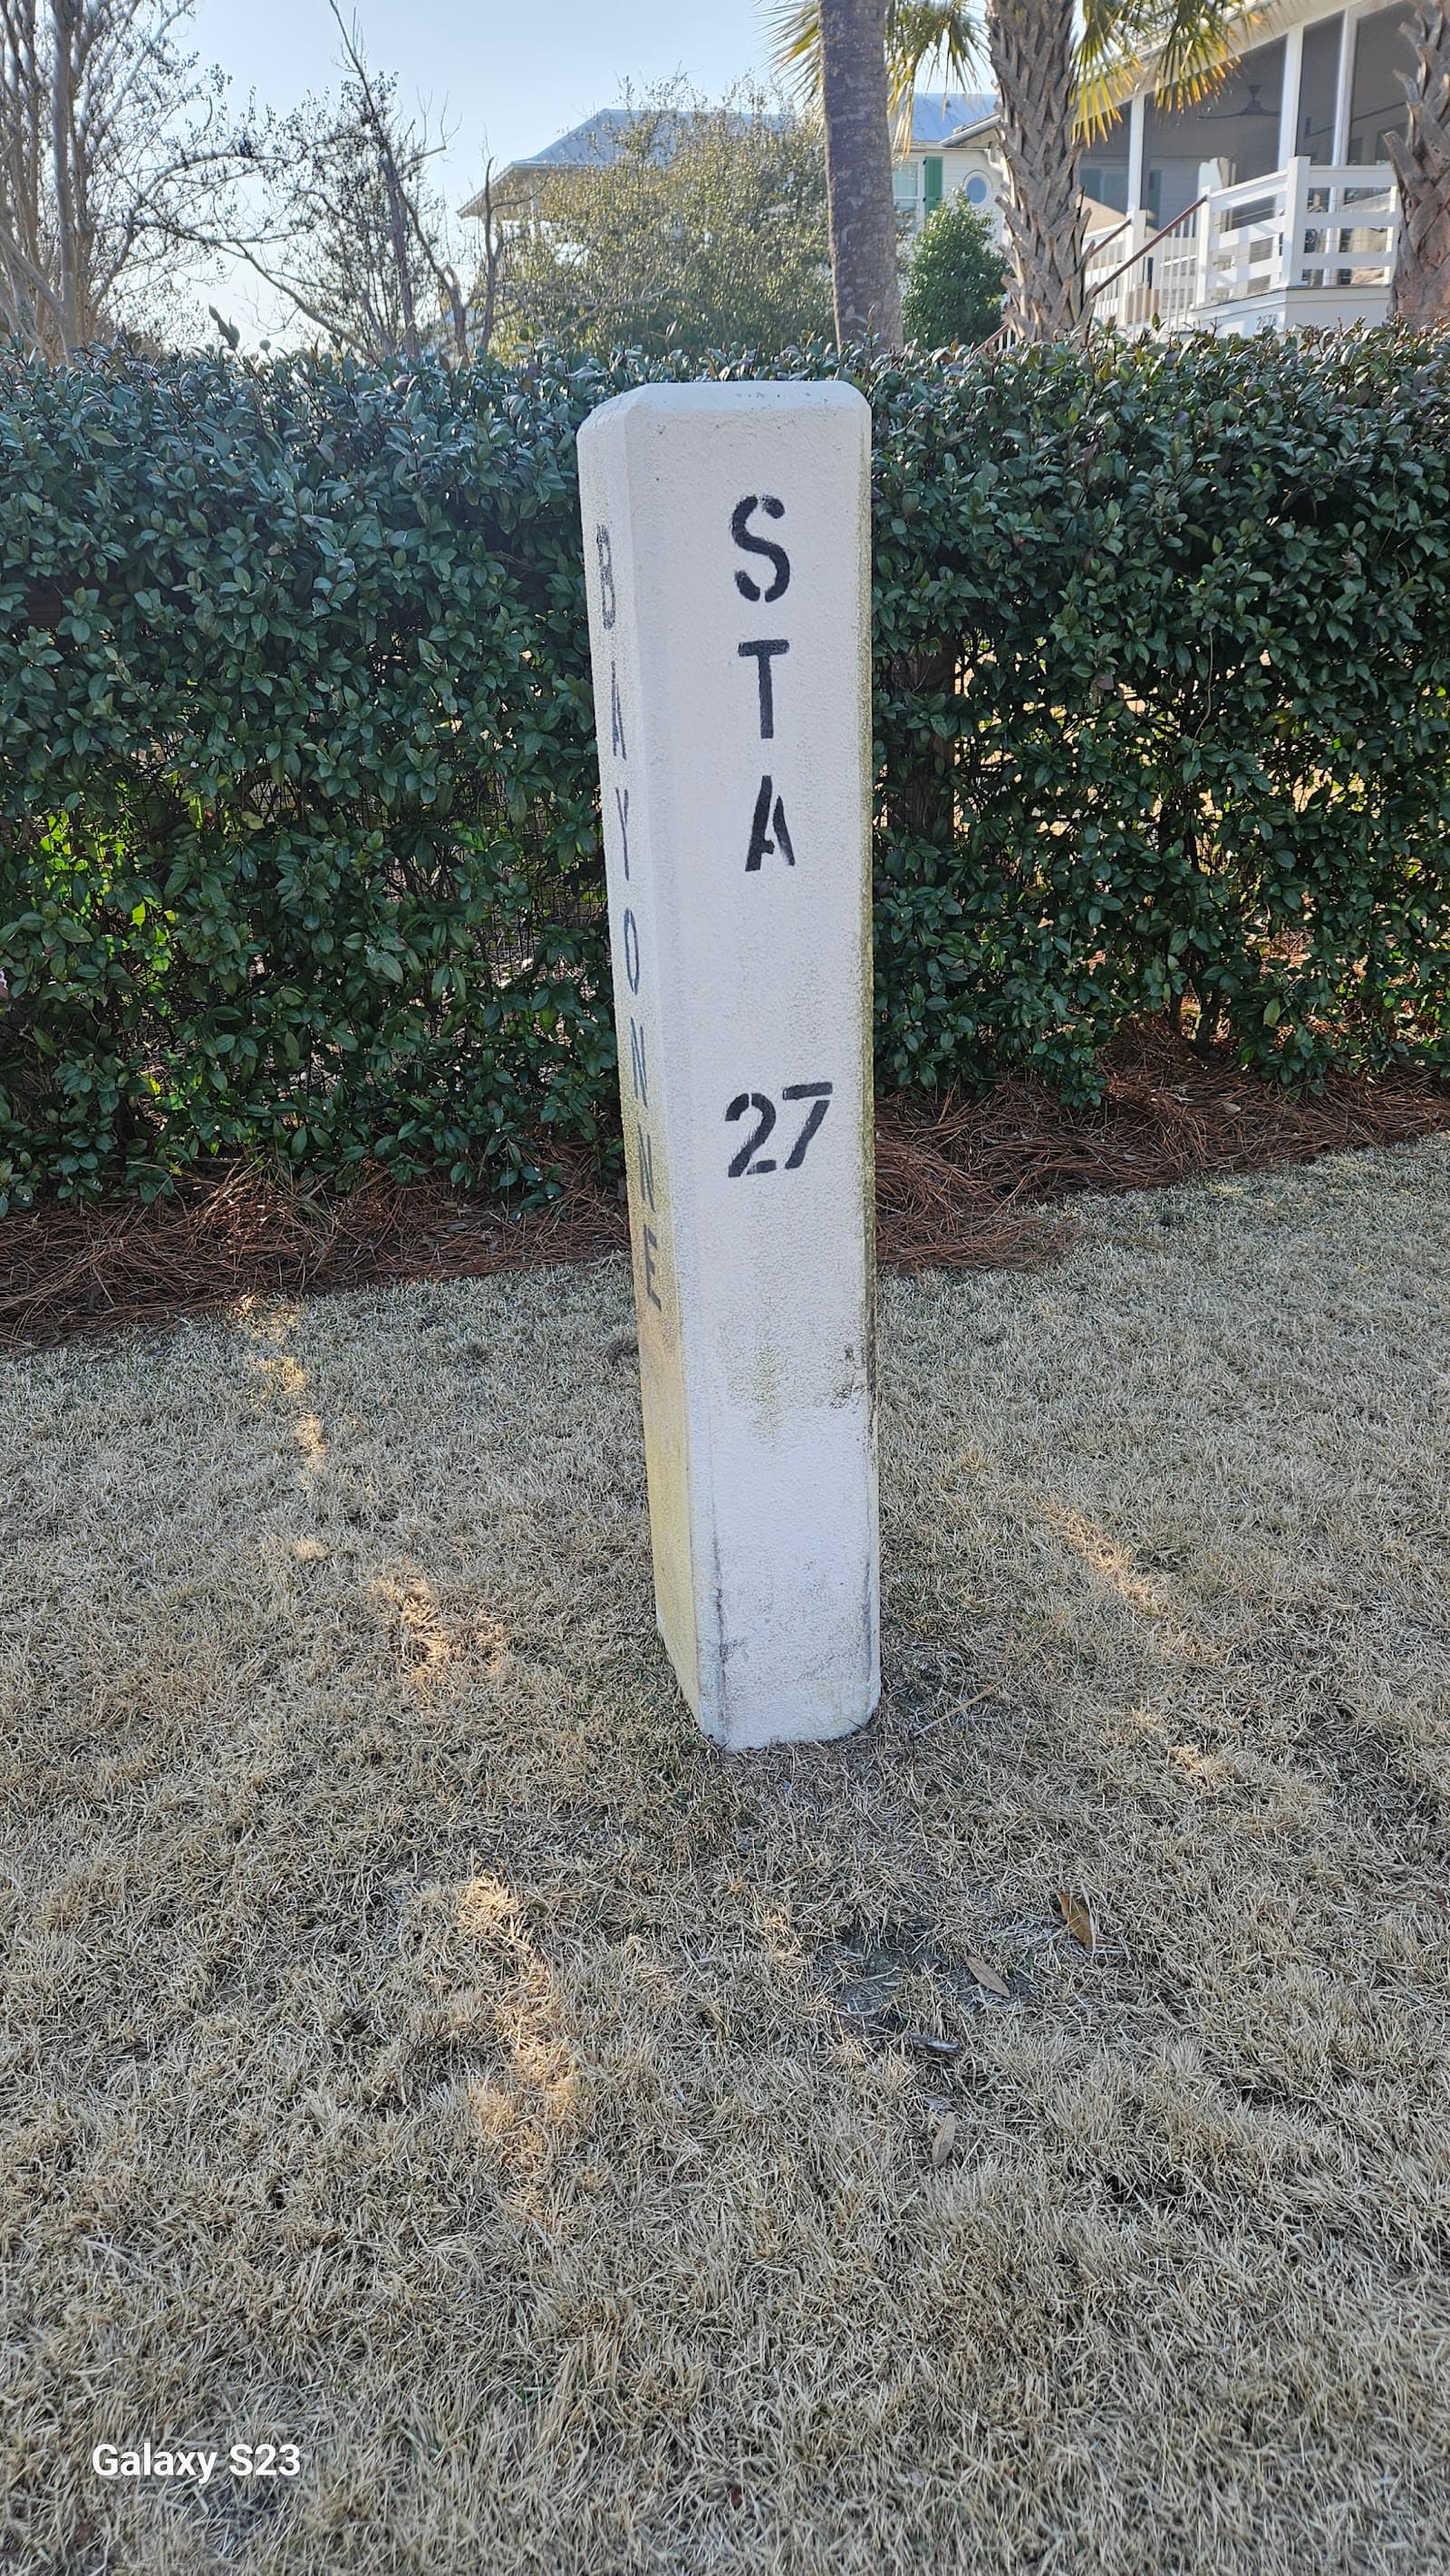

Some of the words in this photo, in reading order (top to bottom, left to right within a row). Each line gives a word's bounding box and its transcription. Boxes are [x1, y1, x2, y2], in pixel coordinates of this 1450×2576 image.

[731, 495, 796, 872] STA
[596, 523, 661, 1311] BAYONNE
[725, 1081, 833, 1177] 27
